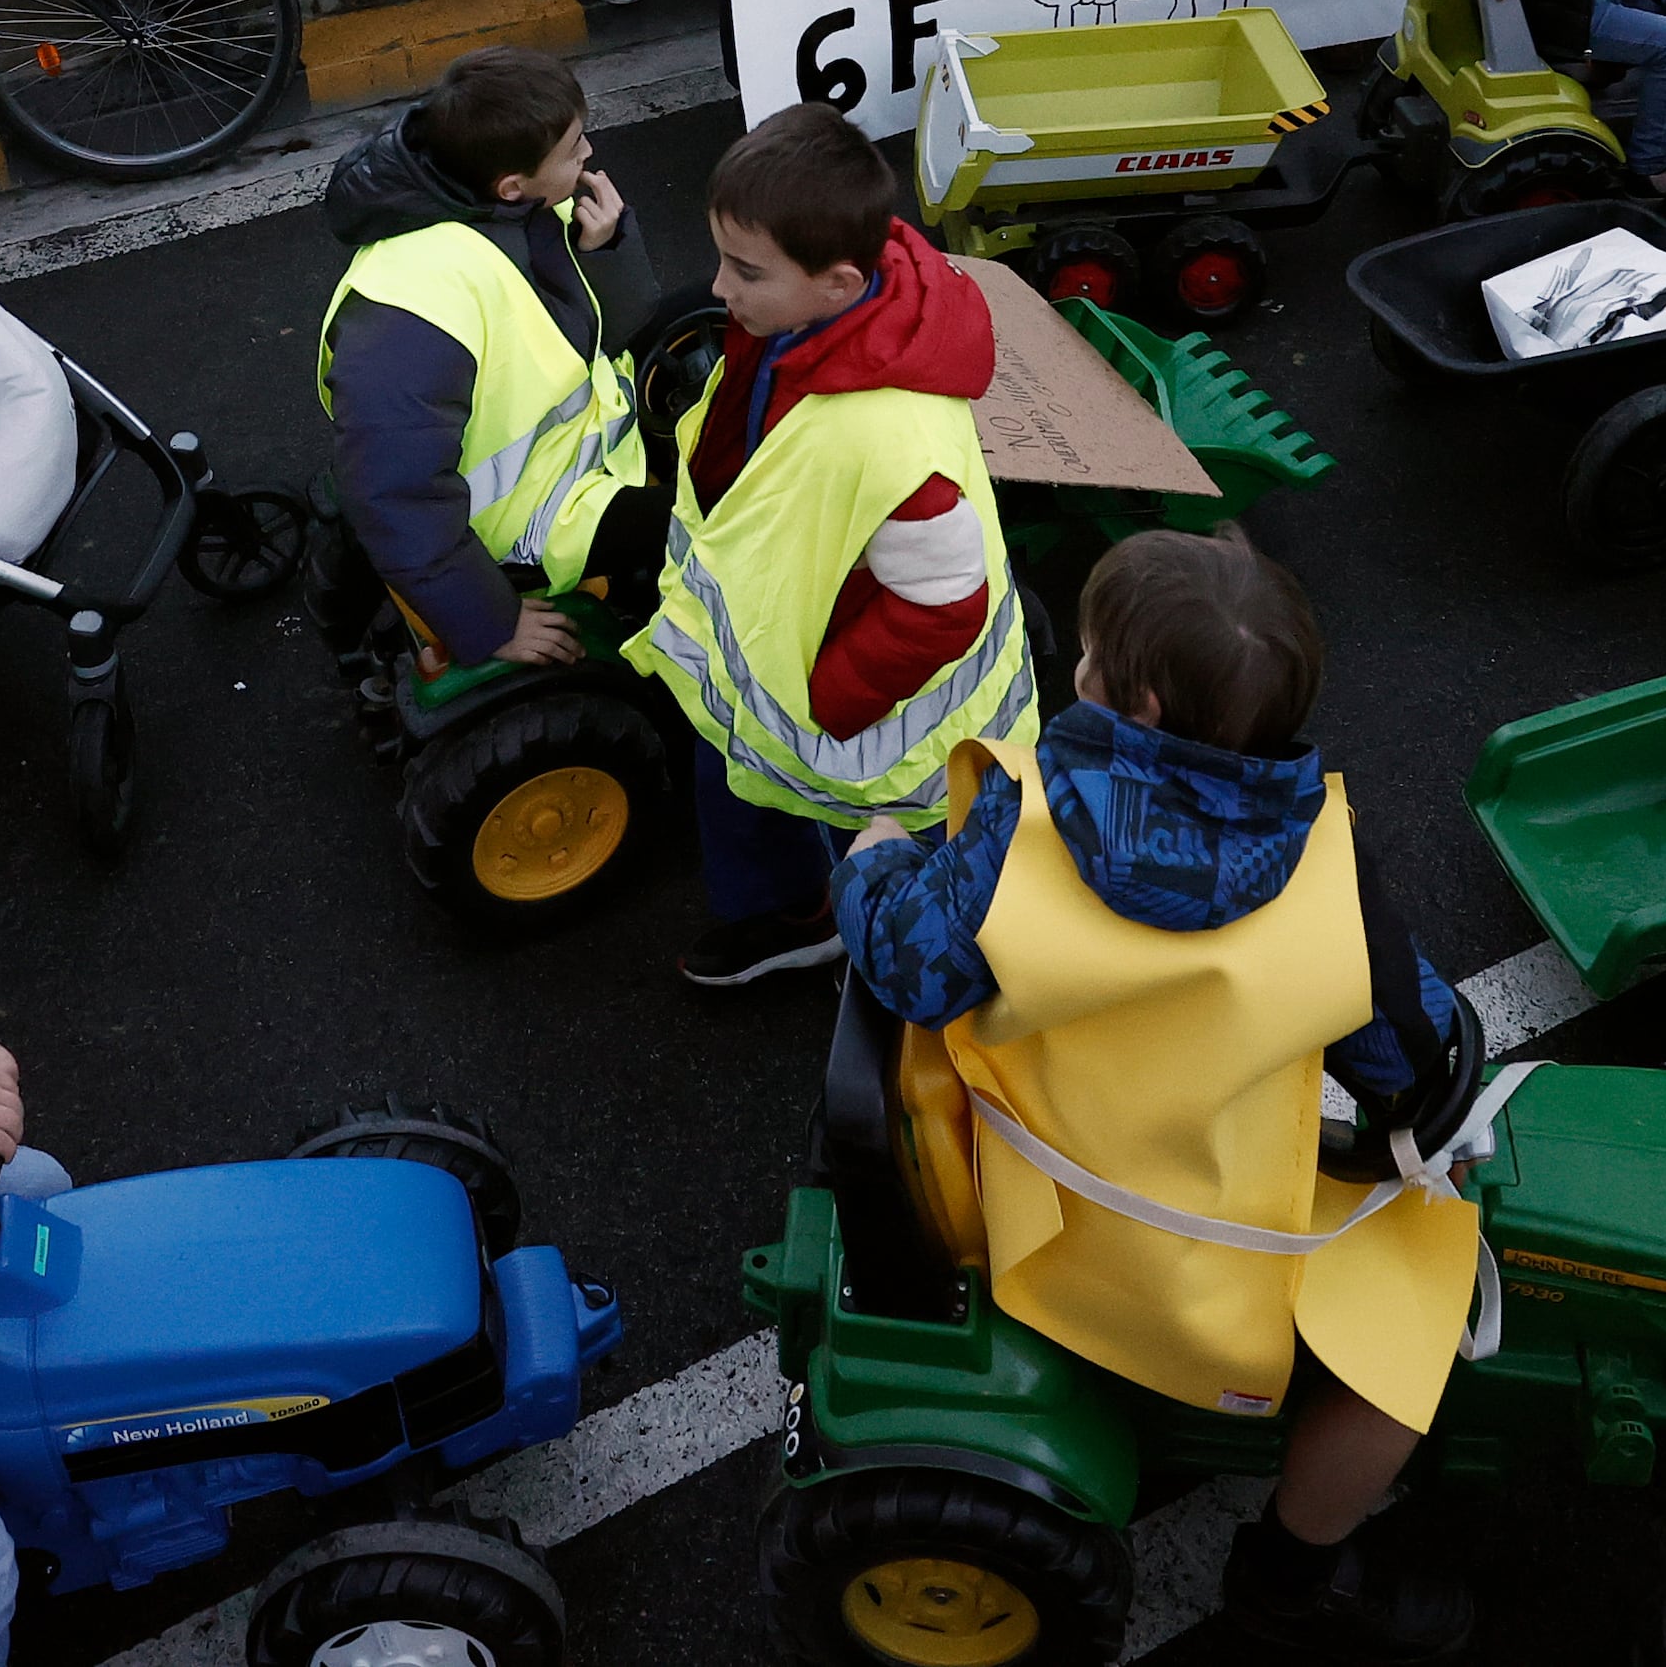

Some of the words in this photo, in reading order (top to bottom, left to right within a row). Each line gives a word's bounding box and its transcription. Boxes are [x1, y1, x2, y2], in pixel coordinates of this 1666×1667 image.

[1115, 149, 1235, 173] CLAAS
[989, 416, 1041, 452] NO
[1514, 1252, 1558, 1273] JOHN
[1562, 1261, 1627, 1285] DEERE
[1508, 1282, 1565, 1303] 7930
[269, 1398, 320, 1419] TD5050
[113, 1426, 160, 1445] New
[165, 1410, 250, 1437] Holland
